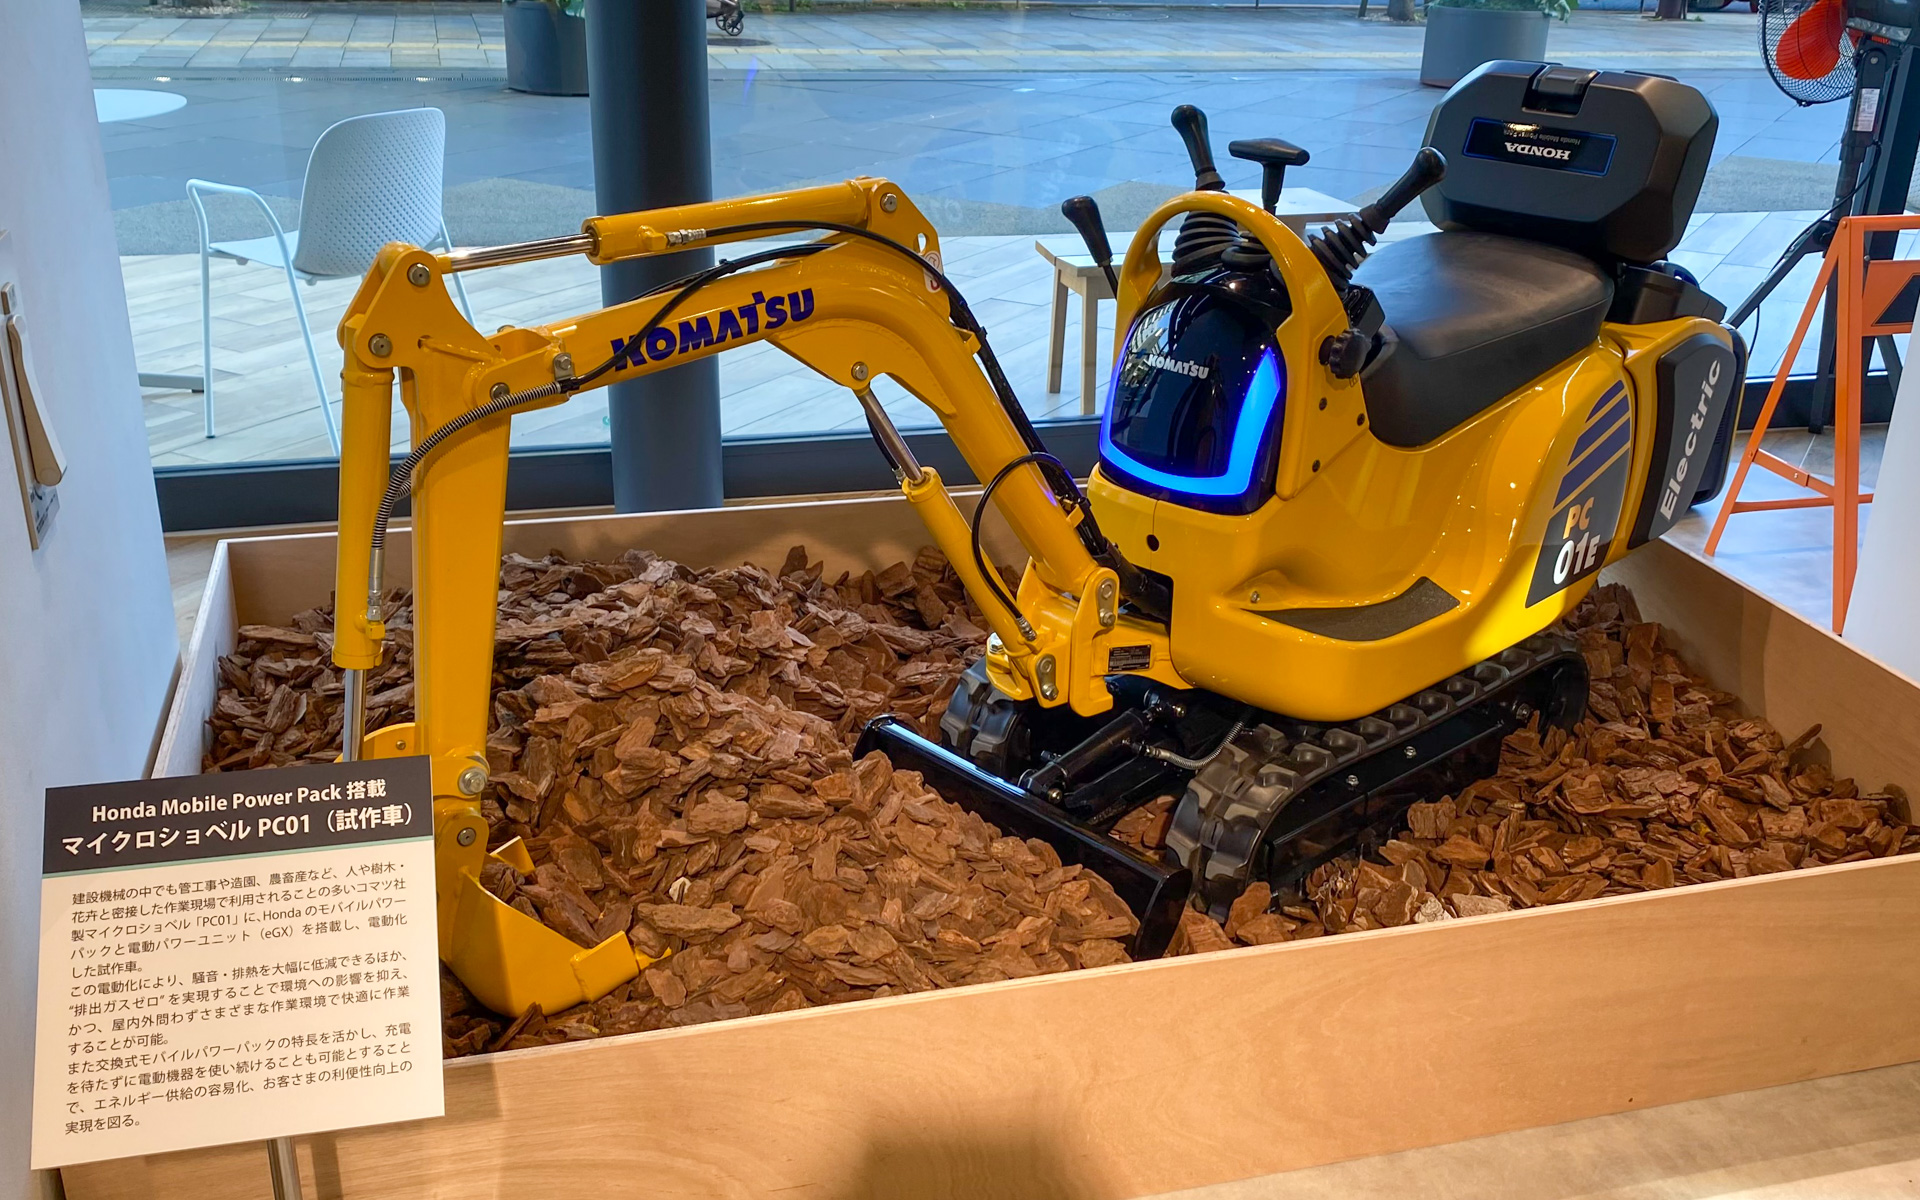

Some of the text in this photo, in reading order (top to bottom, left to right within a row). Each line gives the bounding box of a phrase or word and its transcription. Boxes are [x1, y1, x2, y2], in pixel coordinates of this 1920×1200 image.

[1504, 142, 1571, 160] HONDA
[610, 288, 815, 372] KOMATSU
[1149, 354, 1210, 380] KOMATSU
[1660, 359, 1721, 521] Electric
[1563, 497, 1595, 540] PC
[1553, 531, 1600, 585] 01E
[92, 779, 387, 822] Honda Mobile Power Pack 搭載
[62, 819, 251, 855] マイクロショベル
[72, 960, 143, 979] した試作車。
[68, 1033, 169, 1056] することが可能。
[65, 1114, 140, 1135] 実現を図る。
